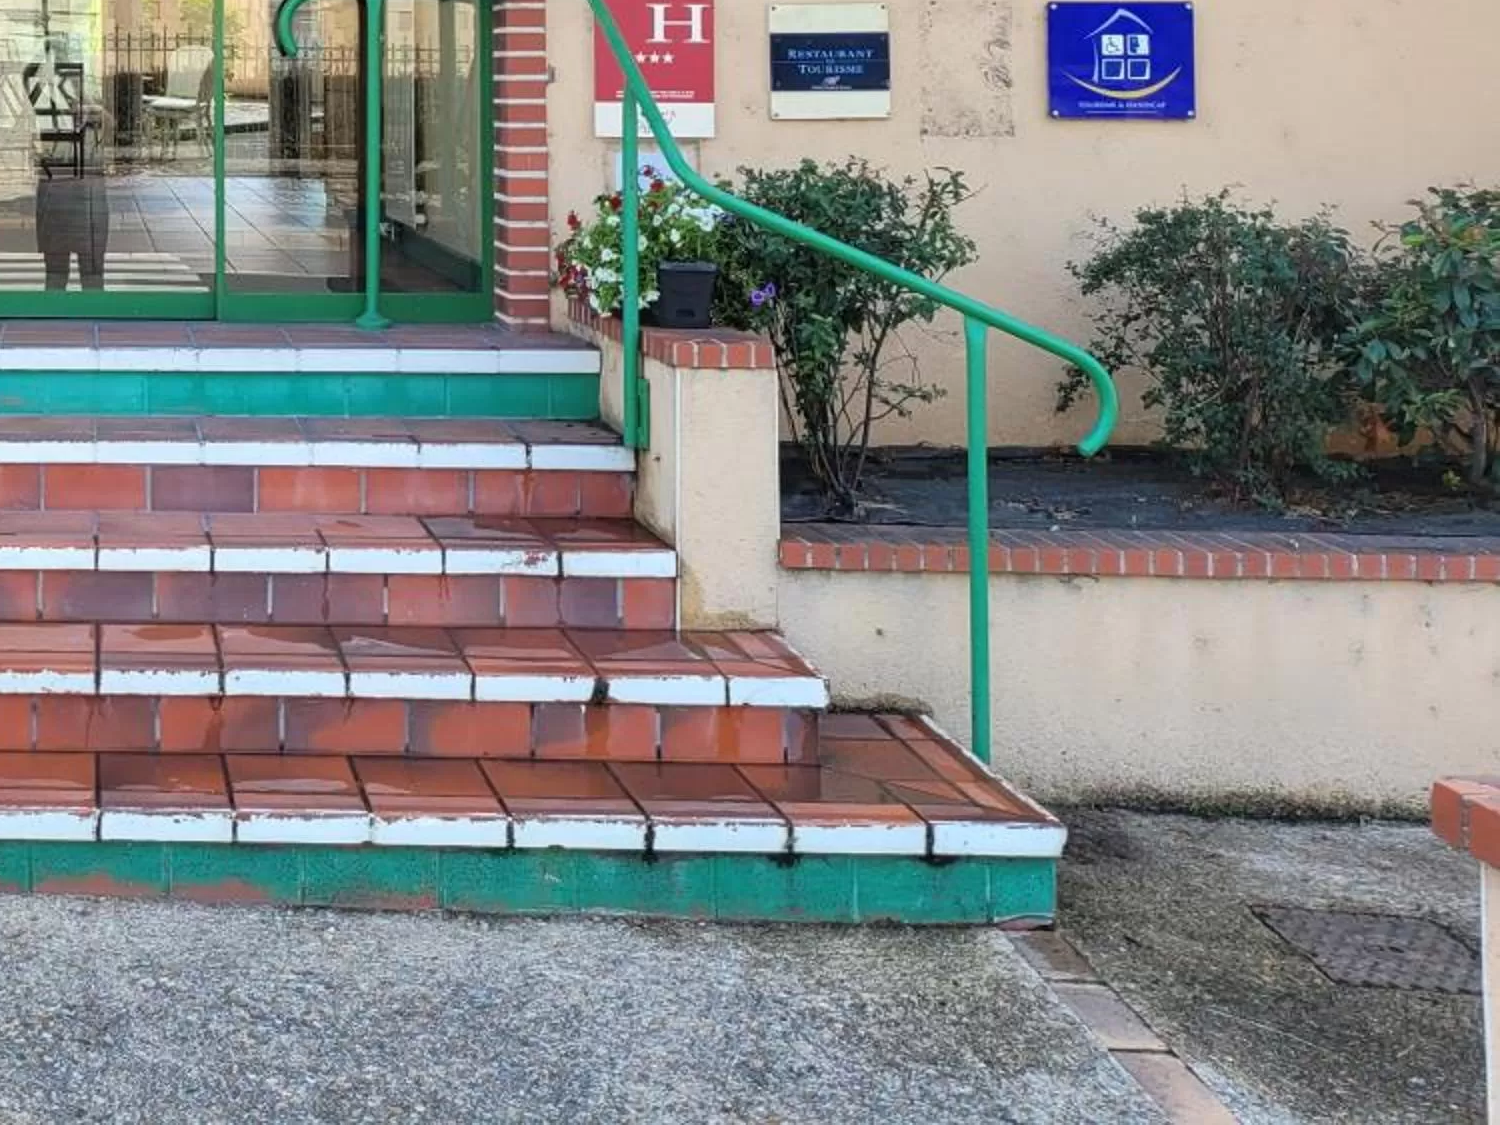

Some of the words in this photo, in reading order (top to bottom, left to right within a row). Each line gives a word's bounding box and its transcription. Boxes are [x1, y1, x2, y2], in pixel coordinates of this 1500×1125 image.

[645, 3, 711, 43] H
[787, 48, 875, 60] RESTAURANT
[797, 64, 864, 74] TOURISME
